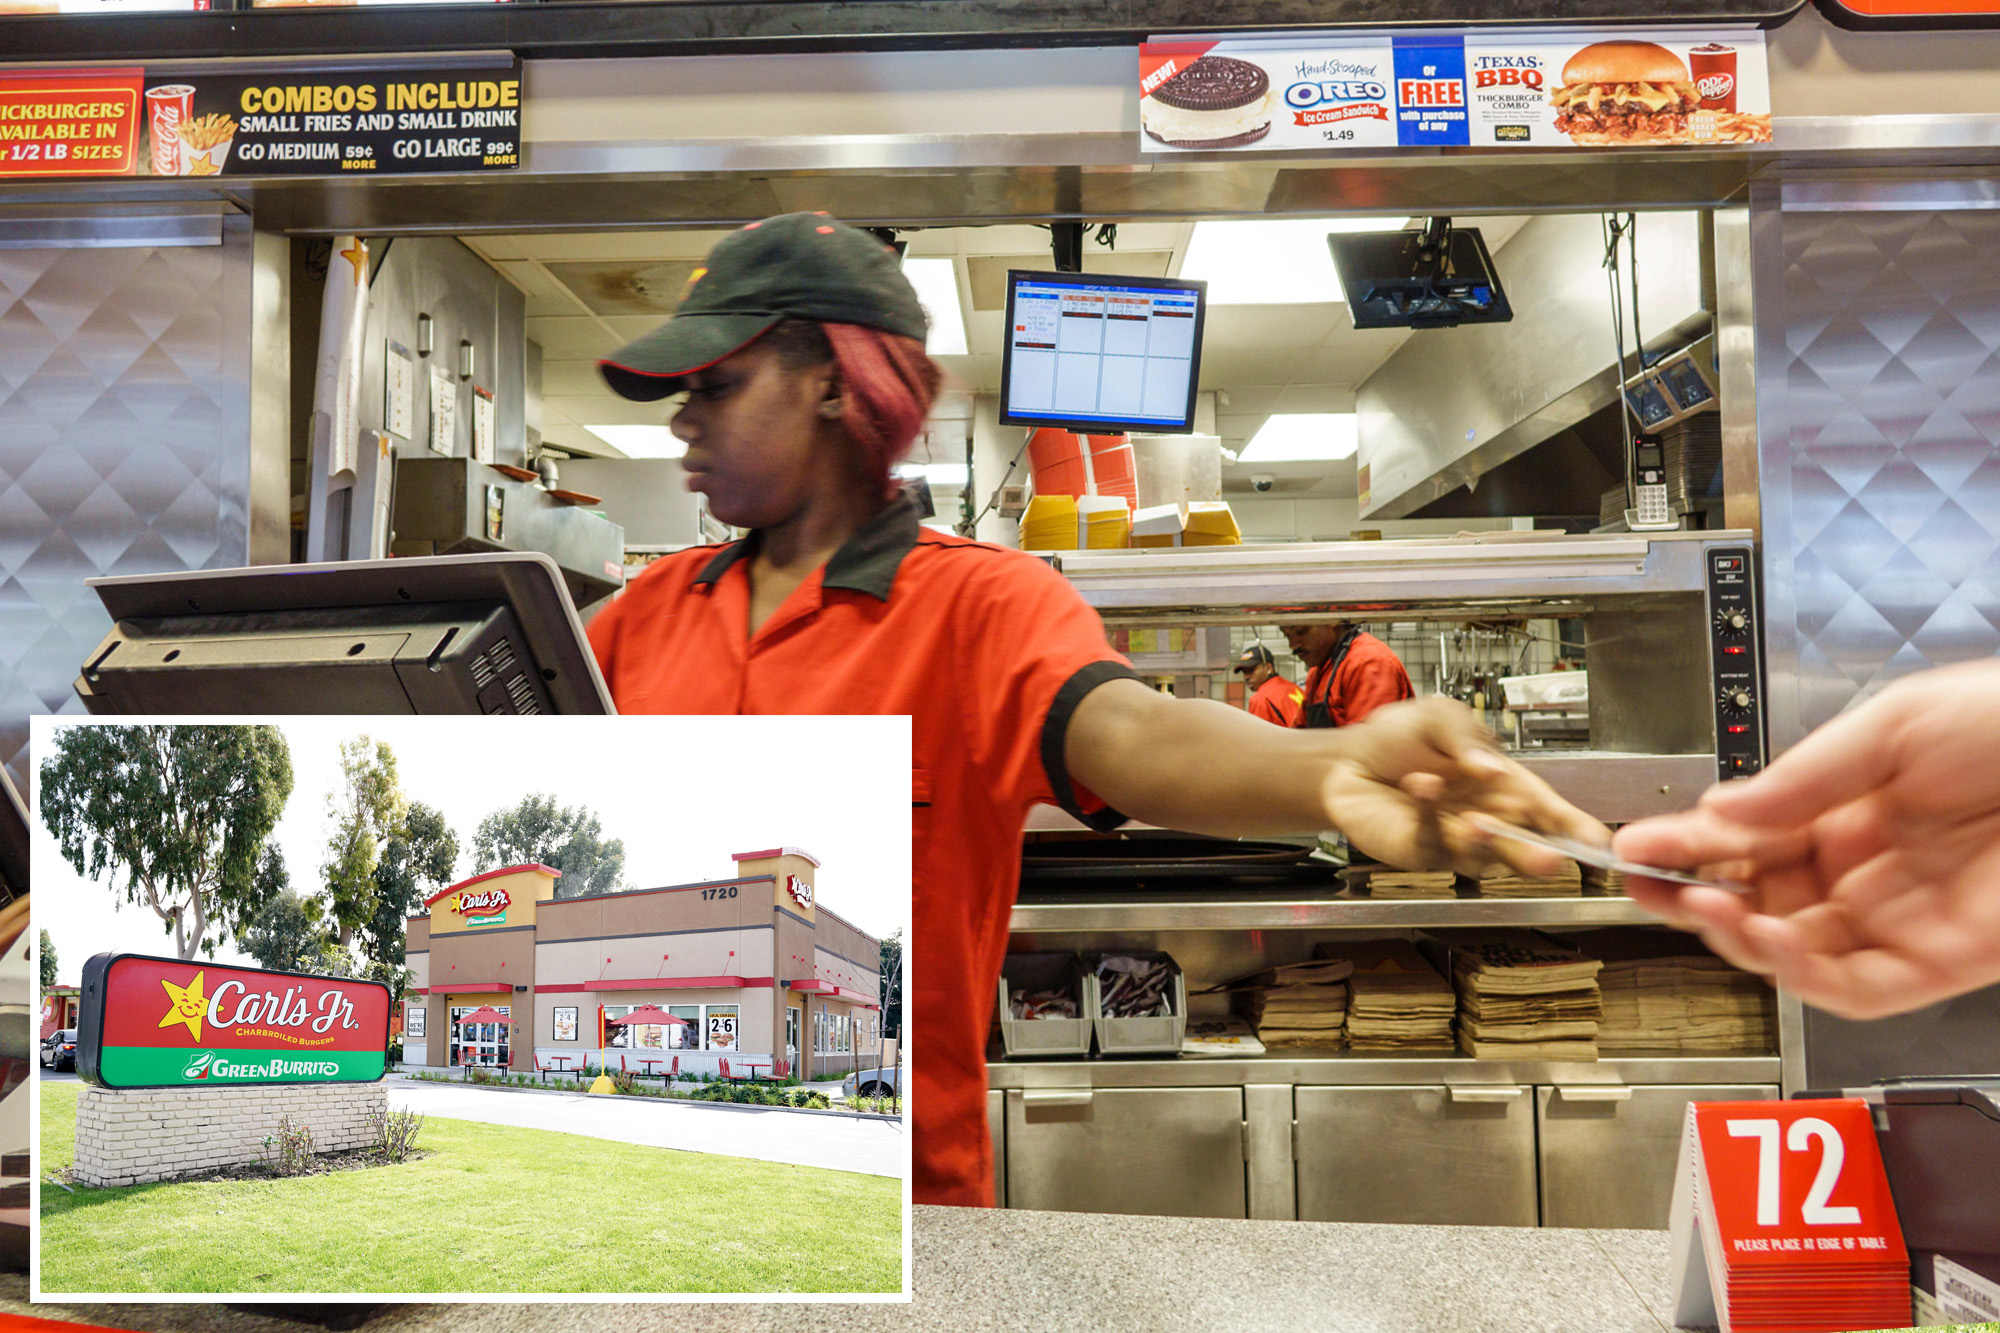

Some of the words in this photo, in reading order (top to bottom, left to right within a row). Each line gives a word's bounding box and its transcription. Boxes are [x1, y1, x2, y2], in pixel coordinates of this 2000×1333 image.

[1295, 59, 1377, 79] Hand-Scooped
[1423, 65, 1436, 76] or
[1478, 56, 1537, 69] TEXAS
[1141, 59, 1177, 93] NEW!
[1475, 68, 1543, 92] BBQ
[241, 84, 377, 113] COMBOS
[386, 80, 519, 111] INCLUDE
[1286, 81, 1386, 107] OREO
[1400, 80, 1462, 105] FREE
[1477, 94, 1544, 102] THICKBURGER
[0, 103, 125, 120] ICKBURGERS
[1303, 112, 1315, 123] Ice
[1316, 111, 1342, 122] Cream
[1342, 104, 1379, 118] Sandwich
[1400, 110, 1421, 120] with
[1422, 110, 1465, 121] purchase
[240, 115, 300, 132] SMALL
[304, 114, 352, 132] FRIES
[355, 114, 394, 131] AND
[398, 112, 457, 130] SMALL
[461, 110, 518, 128] DRINK
[1419, 121, 1429, 131] of
[1430, 122, 1448, 132] any
[0, 123, 91, 140] VAILABLE
[96, 123, 117, 139] IN
[1323, 129, 1354, 140] $1.49
[0, 150, 8, 160] r
[11, 143, 40, 160] 1/2
[44, 144, 67, 160] LB
[72, 145, 123, 159] SIZES
[238, 143, 265, 160] GO
[267, 143, 340, 160] MEDIUM
[345, 145, 373, 158] 59¢
[393, 139, 421, 158] GO
[424, 137, 482, 157] LARGE
[486, 141, 514, 155] 99¢
[342, 159, 376, 169] MORE
[483, 154, 517, 165] MORE
[460, 892, 490, 910] Carl's
[701, 887, 738, 901] 1720
[207, 980, 312, 1029] Carl's
[311, 990, 360, 1034] Jr.
[711, 1018, 719, 1032] 2
[236, 1028, 298, 1044] CHARBROILED
[299, 1036, 335, 1046] BURGERS
[1725, 1117, 1862, 1226] 72
[1734, 1238, 1770, 1250] PLEASE
[1770, 1238, 1802, 1250] PLACE
[1803, 1238, 1815, 1250] AT
[1816, 1237, 1842, 1249] EDGE
[1843, 1237, 1855, 1249] OF
[1857, 1236, 1888, 1249] TABLE
